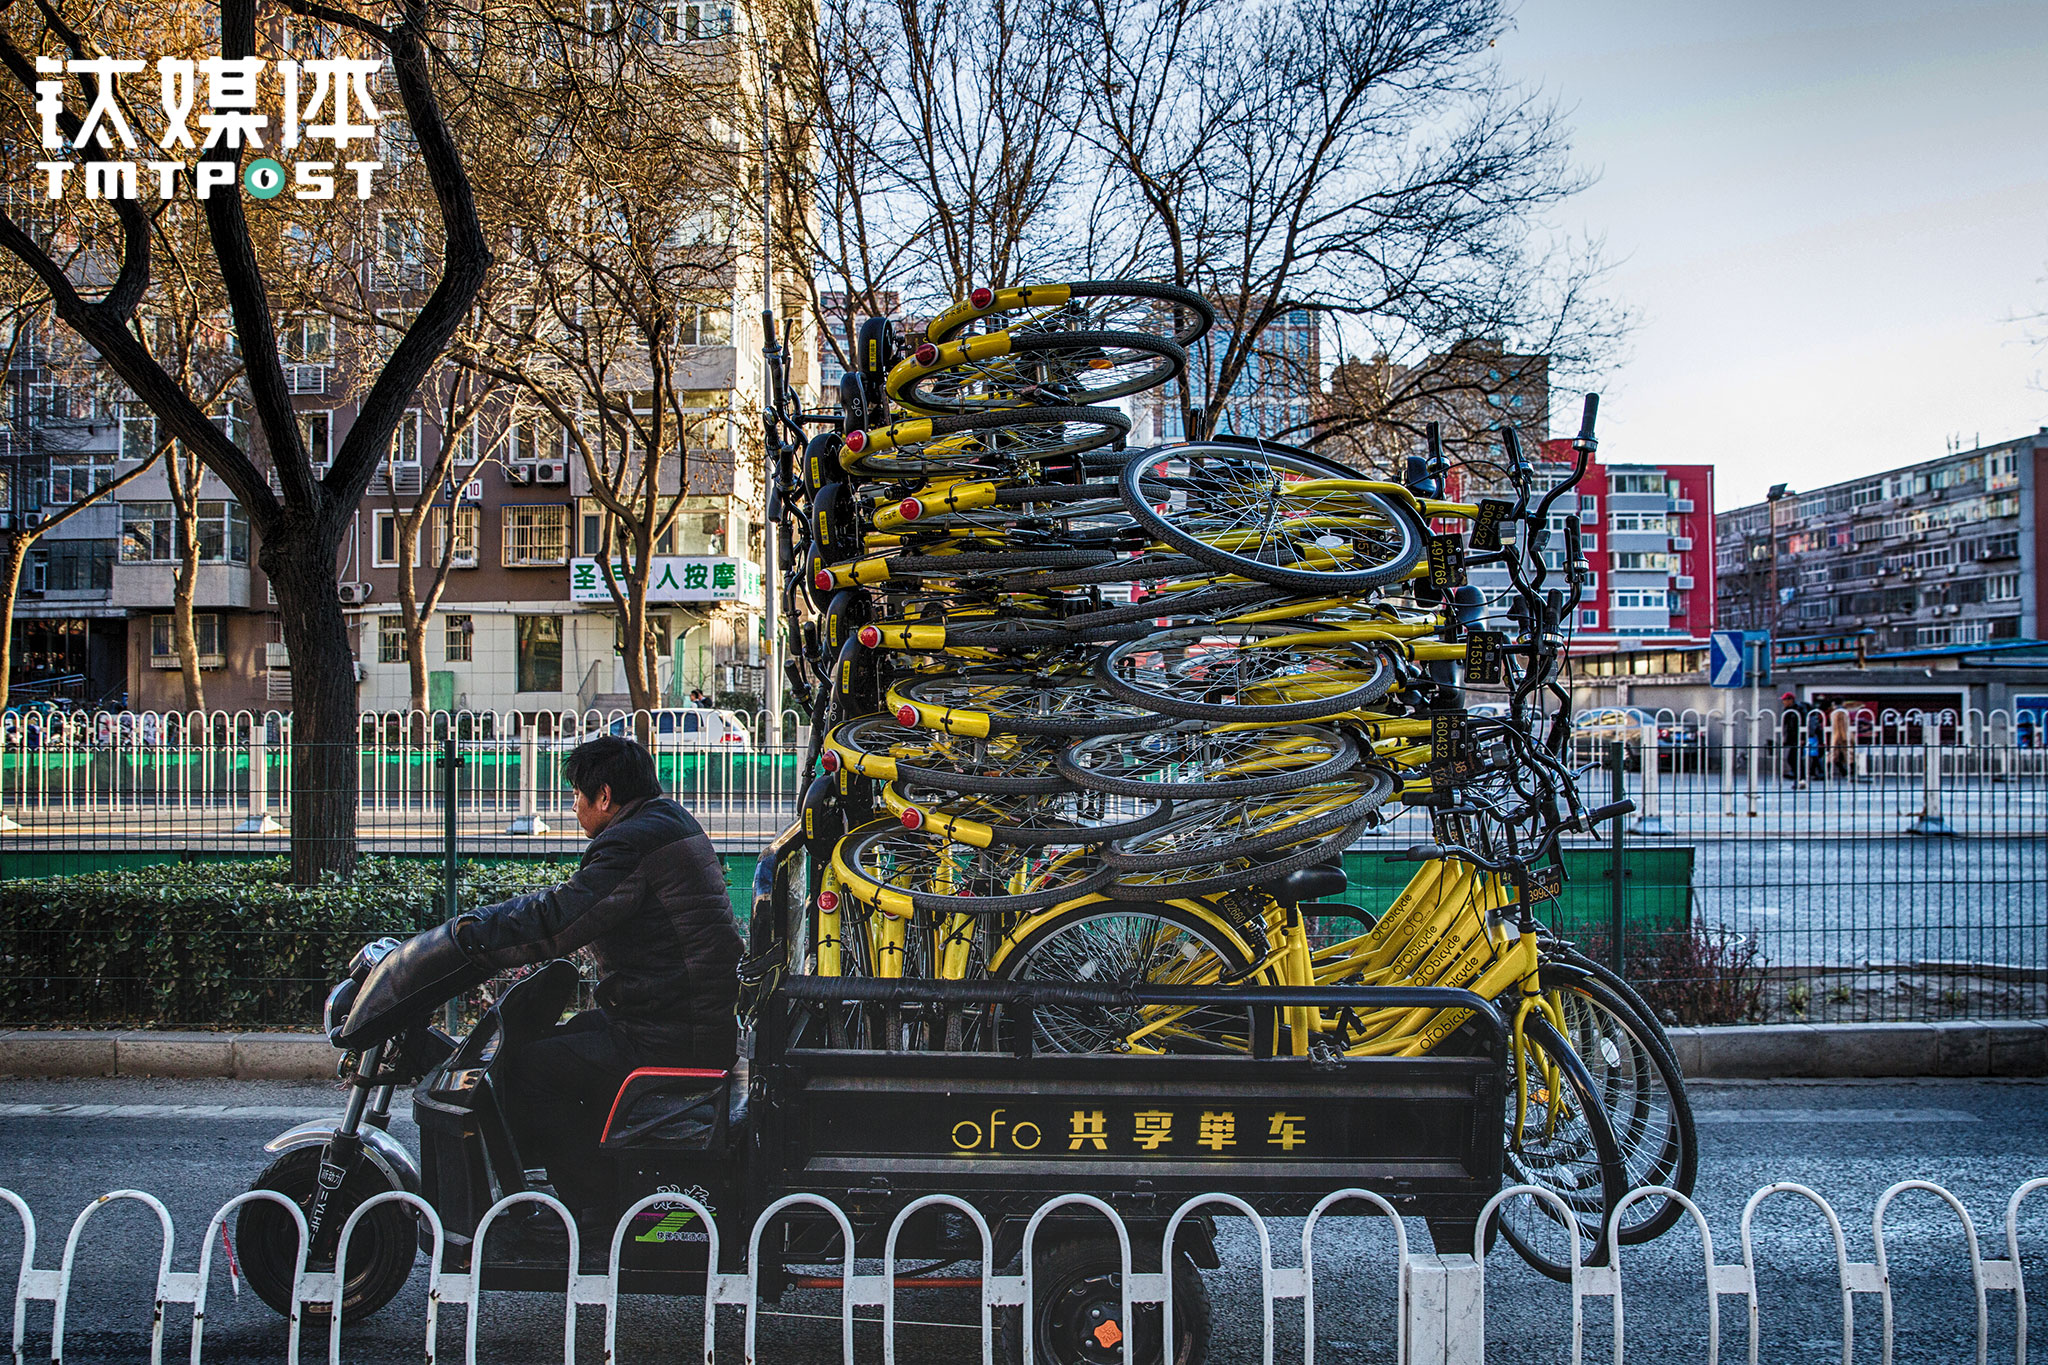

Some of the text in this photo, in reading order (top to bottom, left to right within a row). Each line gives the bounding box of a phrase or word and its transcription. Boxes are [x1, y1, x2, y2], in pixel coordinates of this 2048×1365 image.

[469, 482, 480, 497] 10
[1473, 503, 1496, 546] 506322
[573, 562, 736, 591] 圣手人按摩
[1431, 540, 1448, 585] 497766
[1470, 635, 1484, 680] 415316
[1486, 636, 1495, 651] ofo
[1436, 715, 1449, 758] 460432
[952, 1108, 1306, 1150] ofo 共享单车
